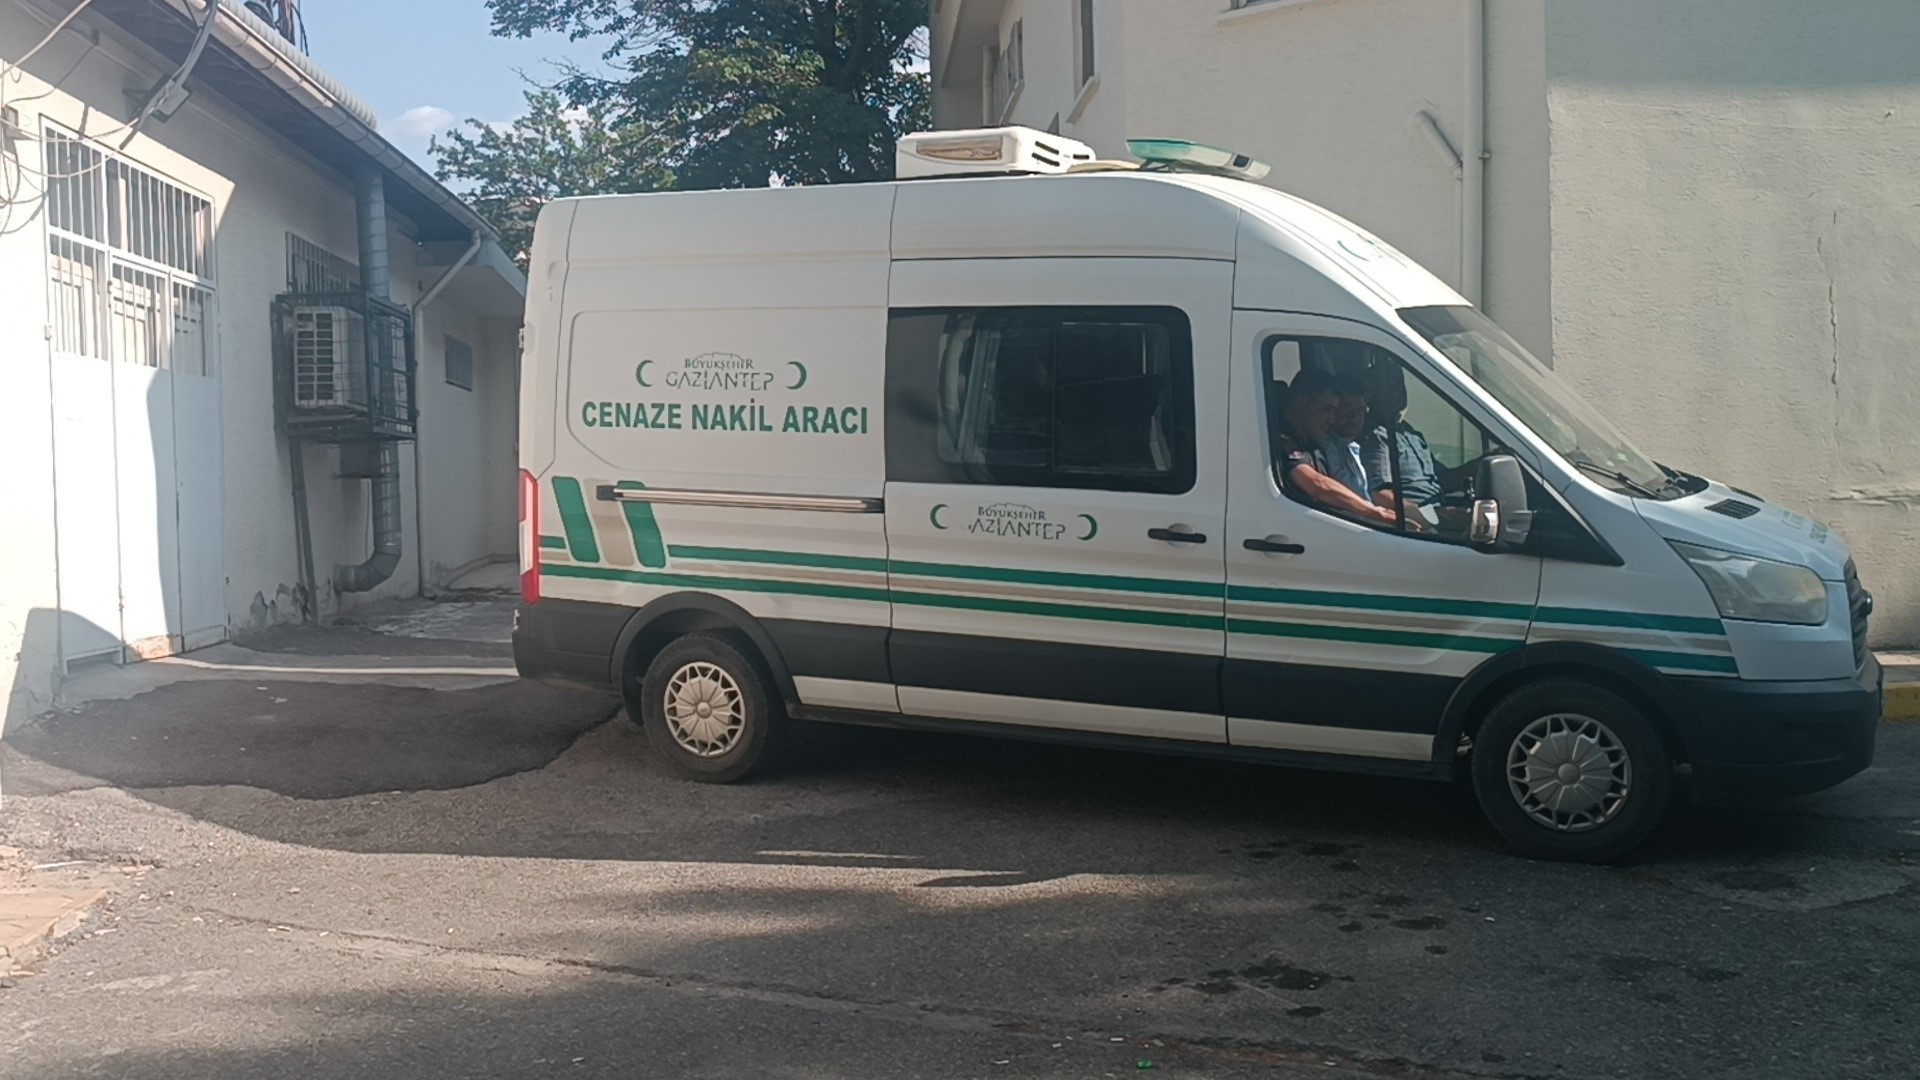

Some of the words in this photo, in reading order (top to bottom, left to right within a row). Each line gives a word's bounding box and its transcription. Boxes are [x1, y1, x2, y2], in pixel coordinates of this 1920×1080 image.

[582, 401, 682, 429] CENAZE
[691, 398, 773, 432] NAKİL
[782, 406, 868, 434] ARACI
